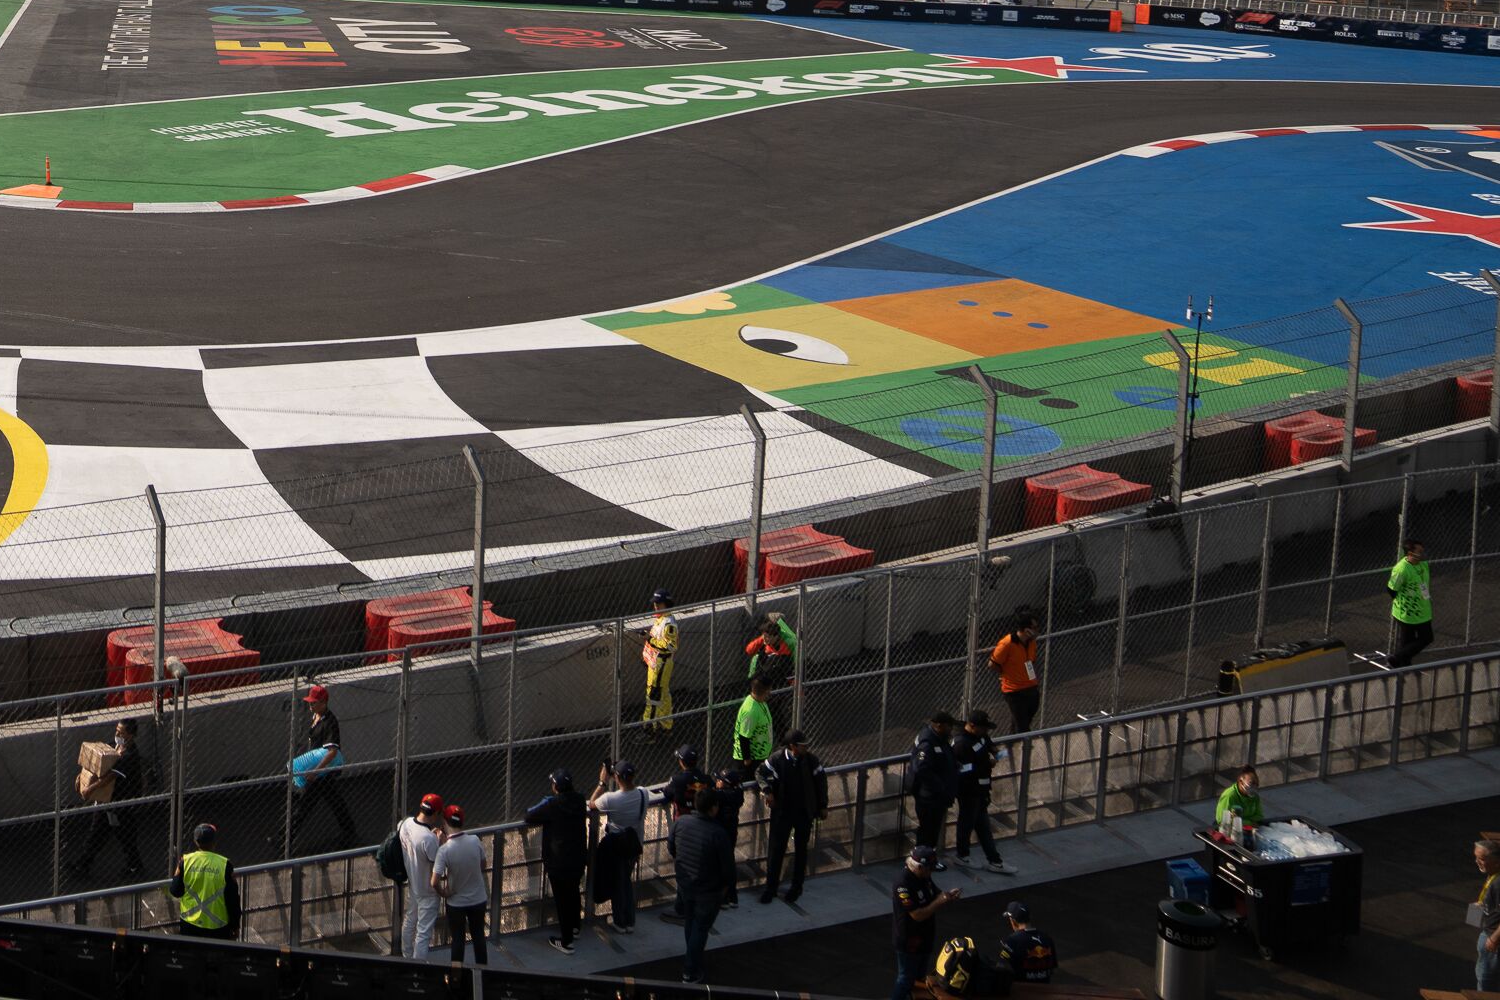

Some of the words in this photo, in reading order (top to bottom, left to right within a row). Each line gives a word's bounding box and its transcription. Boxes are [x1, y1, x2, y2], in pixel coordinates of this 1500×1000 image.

[110, 24, 150, 38] THAT
[207, 5, 348, 67] MEXICO
[330, 17, 471, 54] CITY
[107, 40, 149, 53] CITY
[101, 56, 148, 70] THE
[241, 65, 995, 138] Heineken
[175, 126, 296, 142] SANAMENTE
[1246, 885, 1264, 898] 55
[1165, 927, 1216, 946] BASURA
